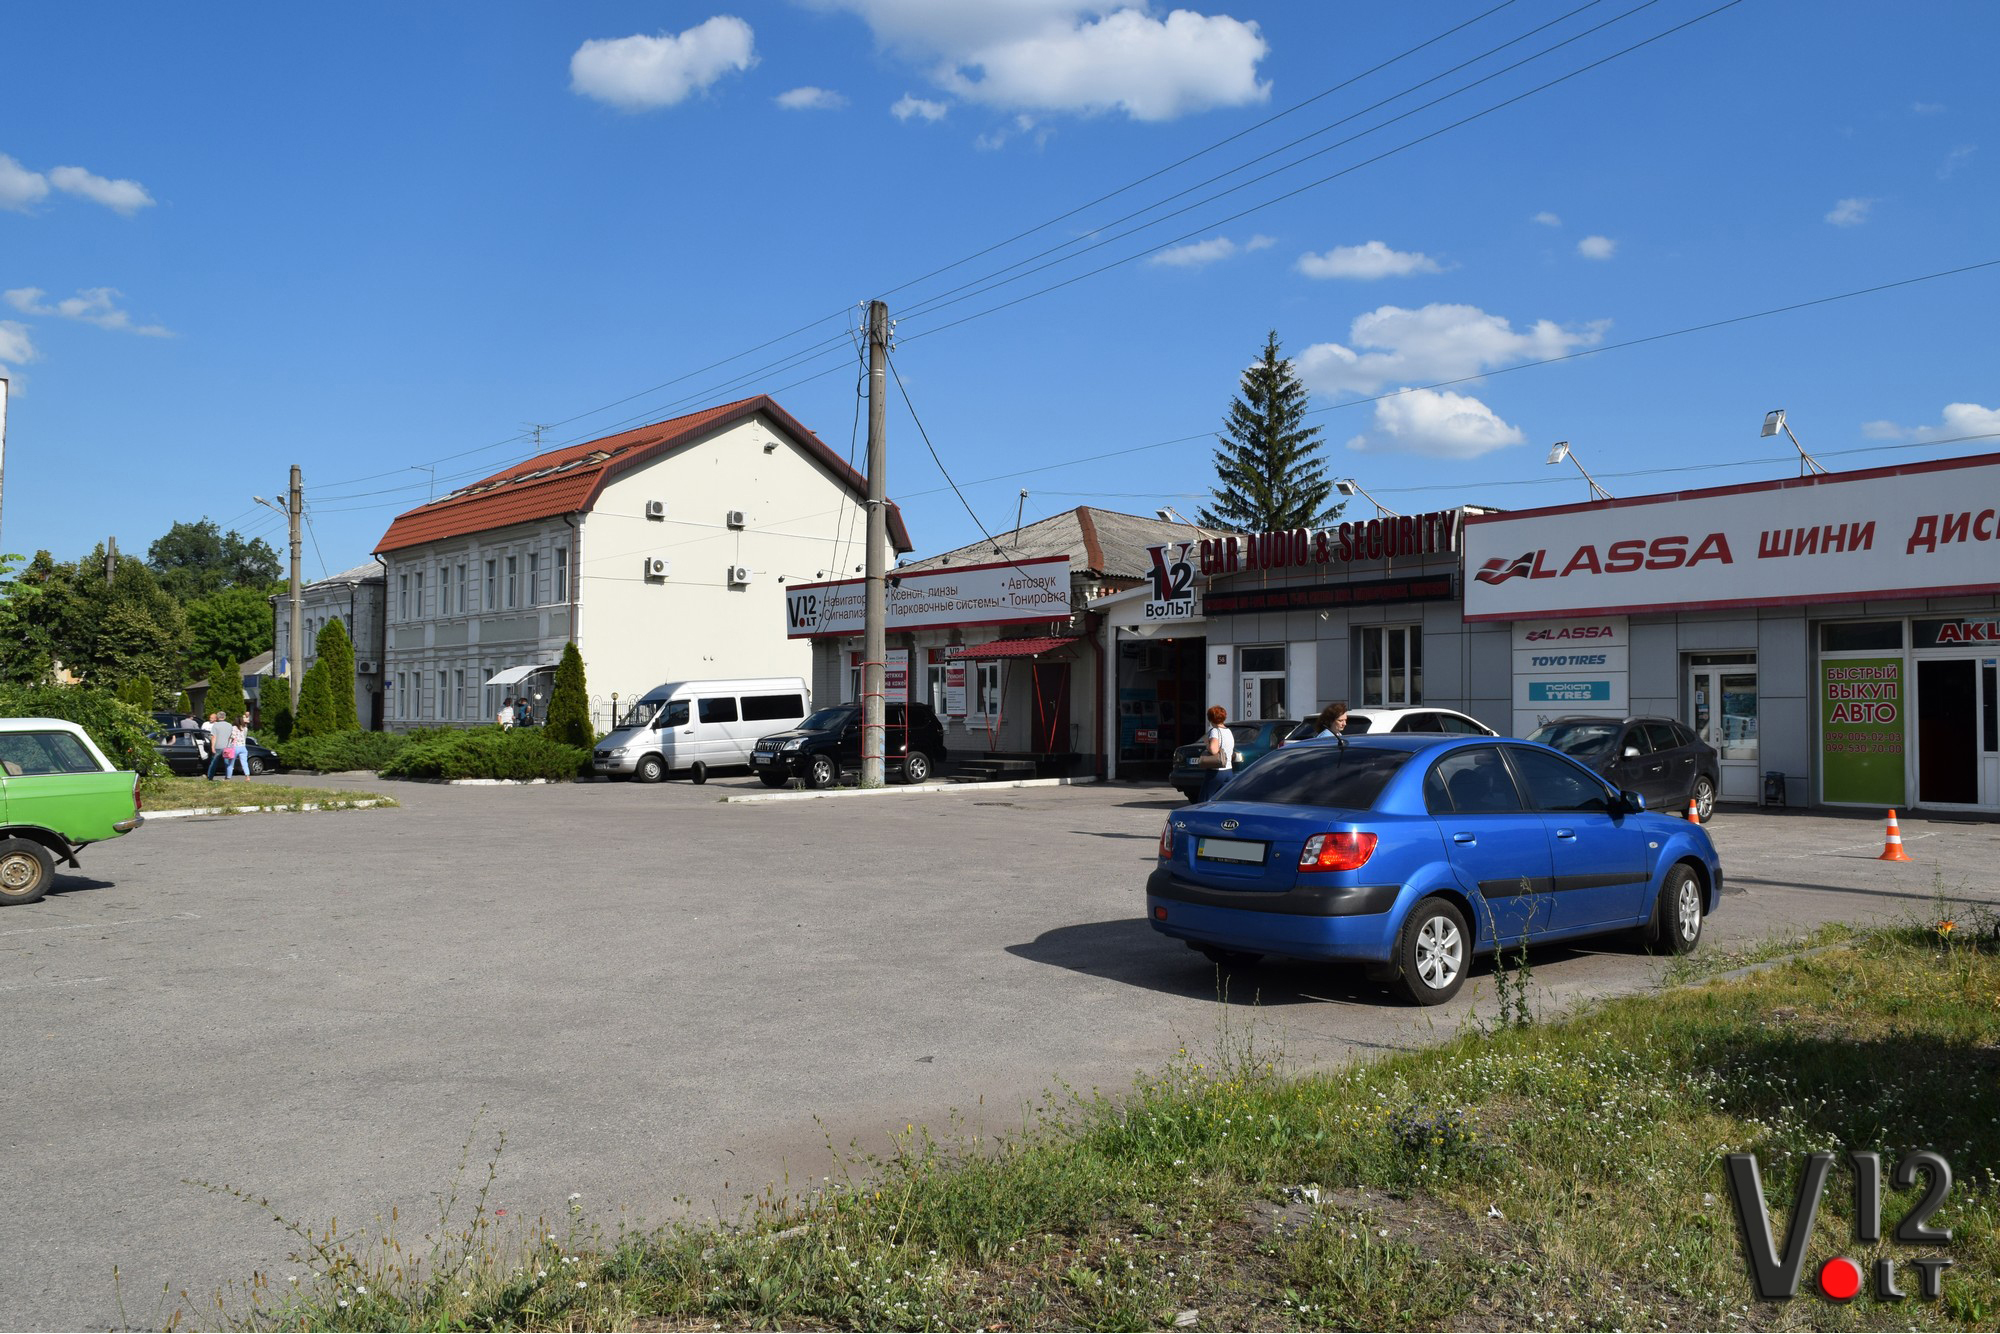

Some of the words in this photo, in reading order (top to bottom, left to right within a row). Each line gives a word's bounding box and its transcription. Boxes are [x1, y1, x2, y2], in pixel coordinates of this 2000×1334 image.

[1758, 520, 1876, 559] ШИНИ
[1906, 508, 2000, 555] ДИС
[1200, 537, 1239, 576] CAR
[1246, 528, 1310, 571] AUDIO
[1315, 532, 1334, 565] &
[1339, 510, 1459, 563] SECURITY
[1528, 532, 1733, 580] LASSA
[1008, 575, 1056, 591] Автозвук
[928, 586, 958, 598] линзы
[1009, 590, 1067, 607] Тонировка
[824, 595, 866, 606] Навигатор
[891, 600, 954, 617] Парковочные
[956, 597, 1000, 610] системы
[824, 608, 866, 621] Сигнализа
[1545, 626, 1613, 640] LASSA
[1531, 655, 1567, 667] TOYO
[1567, 654, 1607, 666] TIRES
[1827, 664, 1898, 680] БЫСТРЫЙ
[1546, 683, 1592, 691] nokian
[1828, 682, 1897, 700] ВЫКУП
[1245, 682, 1253, 718] ШИНО
[1546, 691, 1592, 700] TYRES
[1829, 702, 1897, 724] АВТО
